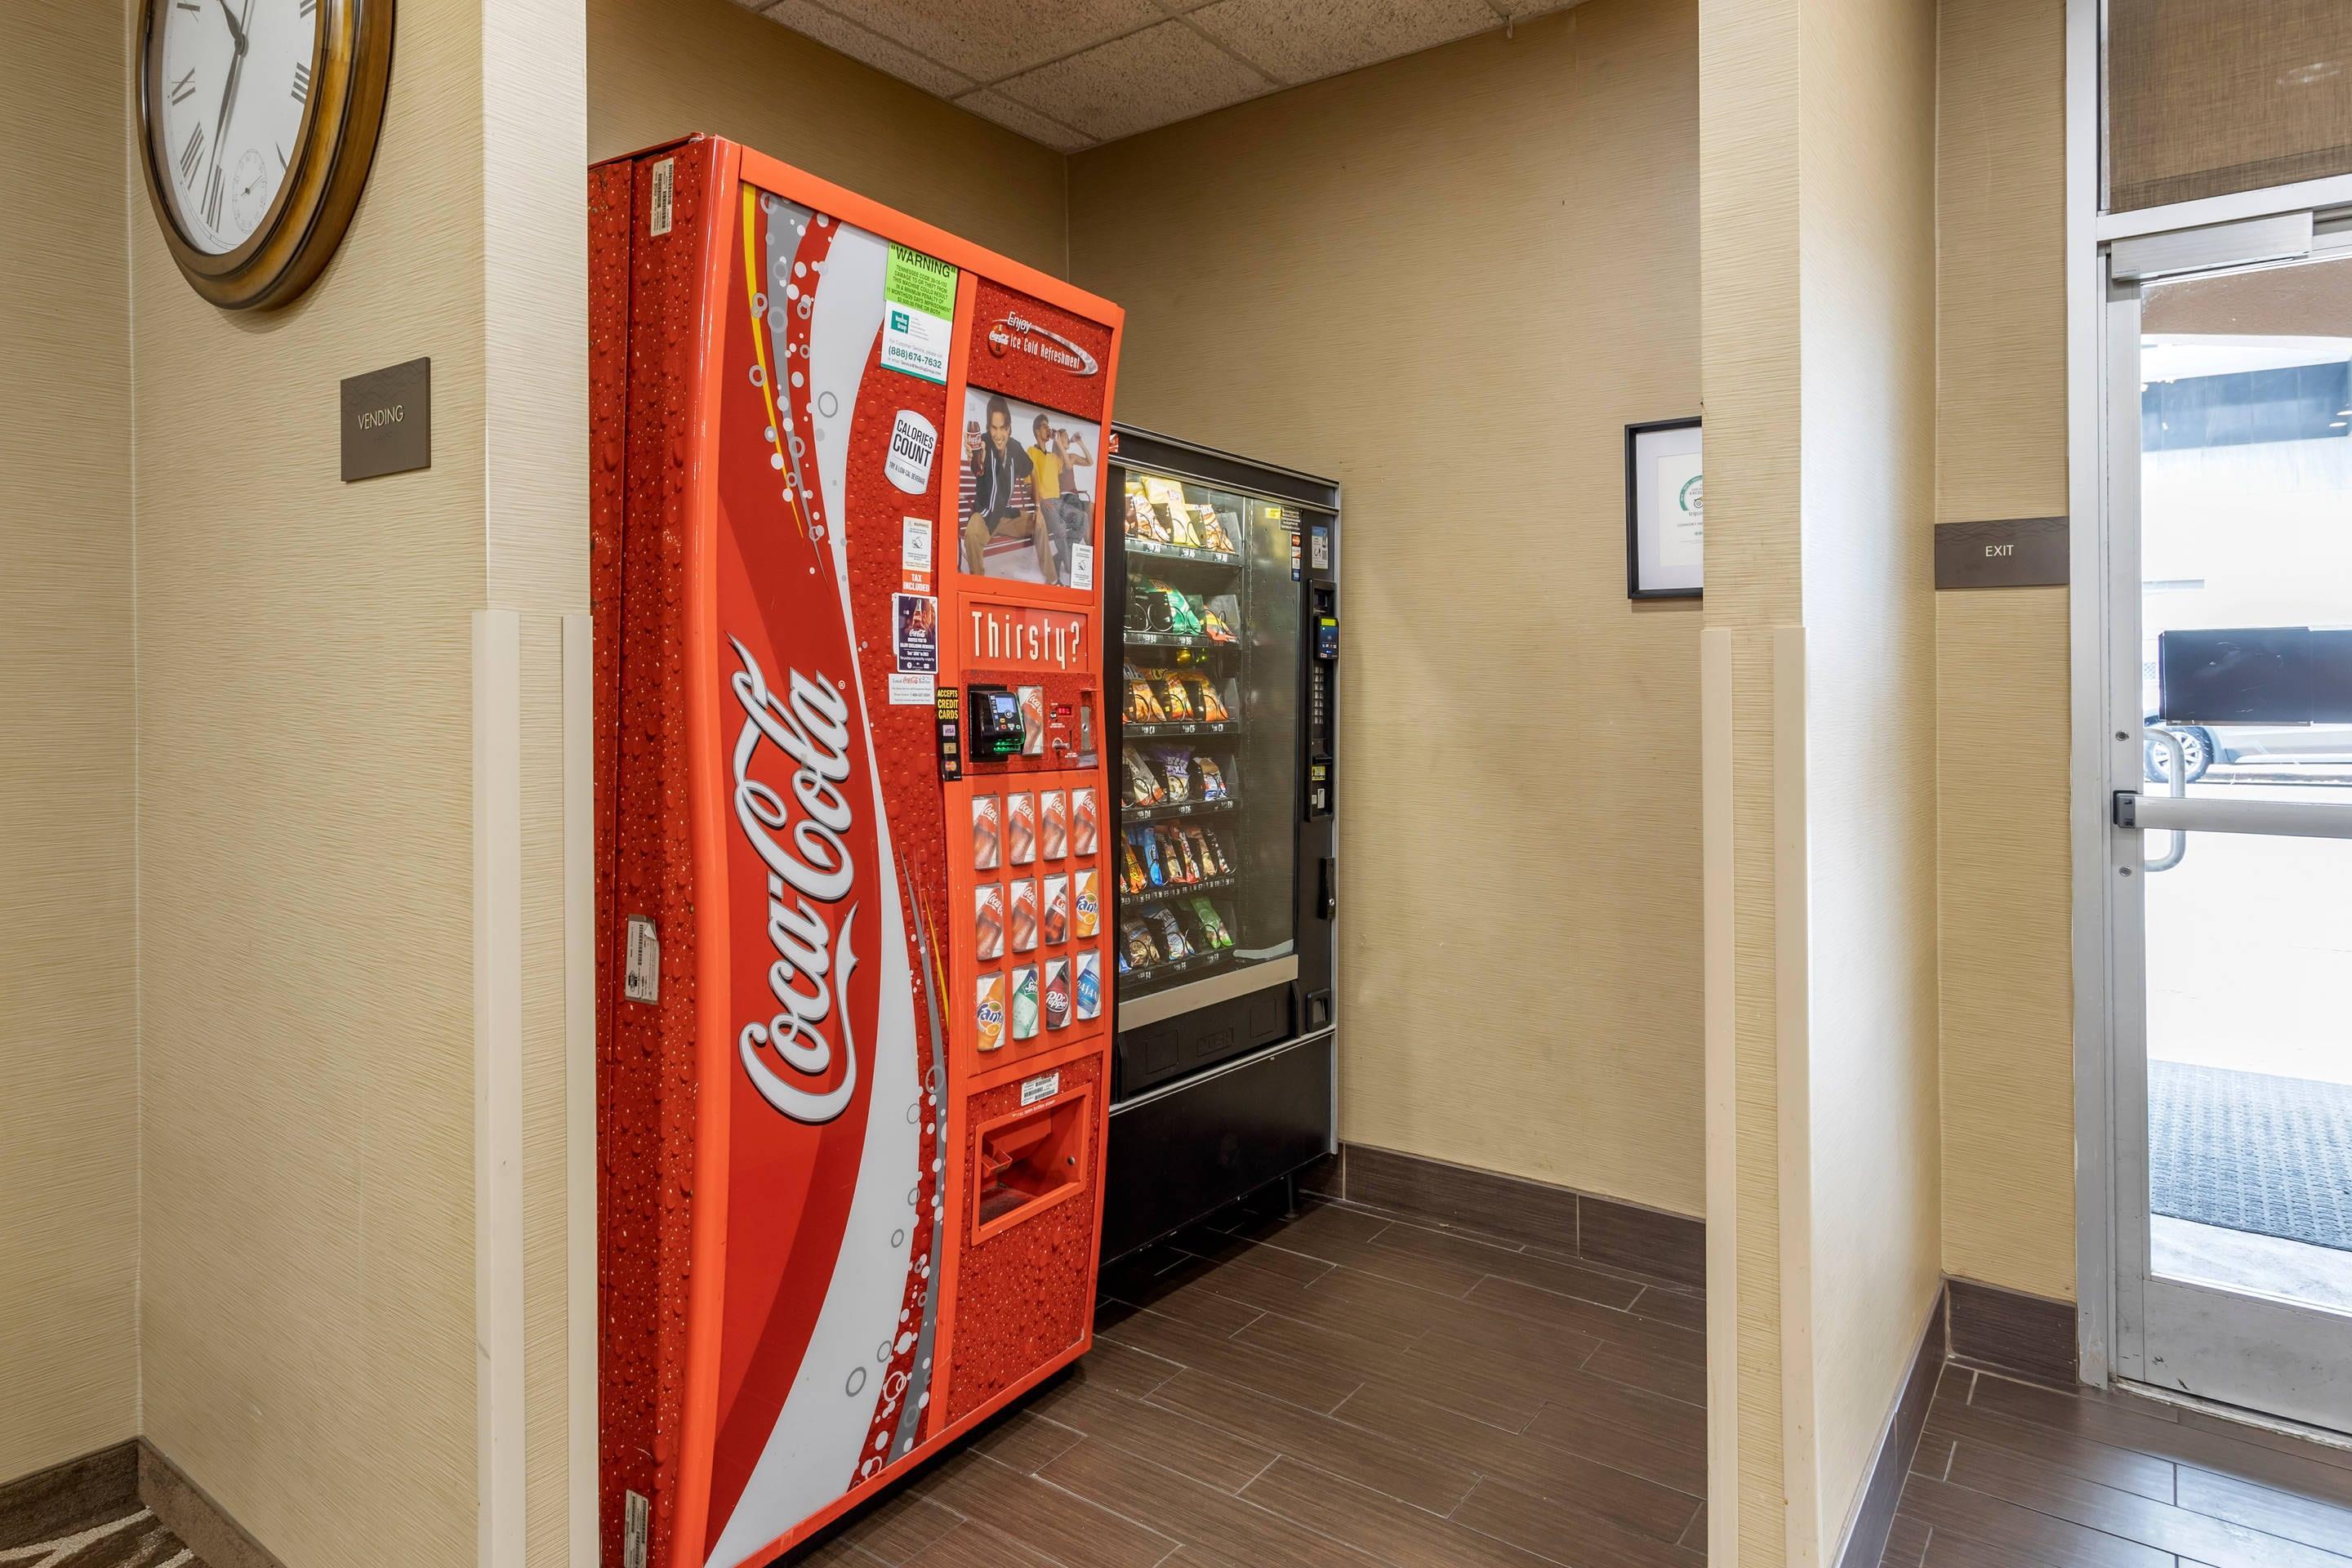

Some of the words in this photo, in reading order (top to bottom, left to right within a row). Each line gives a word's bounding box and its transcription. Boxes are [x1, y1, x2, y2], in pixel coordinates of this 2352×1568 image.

[1007, 311, 1032, 333] Enjoy
[889, 345, 942, 369] (888)674-7632
[1010, 333, 1021, 350] Ice
[1023, 337, 1038, 355] Cold
[1040, 343, 1080, 370] Refreshment
[358, 404, 404, 430] VENDING
[897, 419, 934, 450] CALORIES
[893, 433, 931, 467] COUNT
[1985, 544, 2015, 557] EXIT
[902, 581, 930, 592] INCLUDED
[911, 573, 922, 582] TAX
[971, 611, 1080, 670] Thirsty?
[938, 689, 958, 698] ACCEPTS
[938, 698, 959, 709] CREDIT
[938, 709, 959, 719] CARDS
[725, 630, 860, 1126] Coca-Cola
